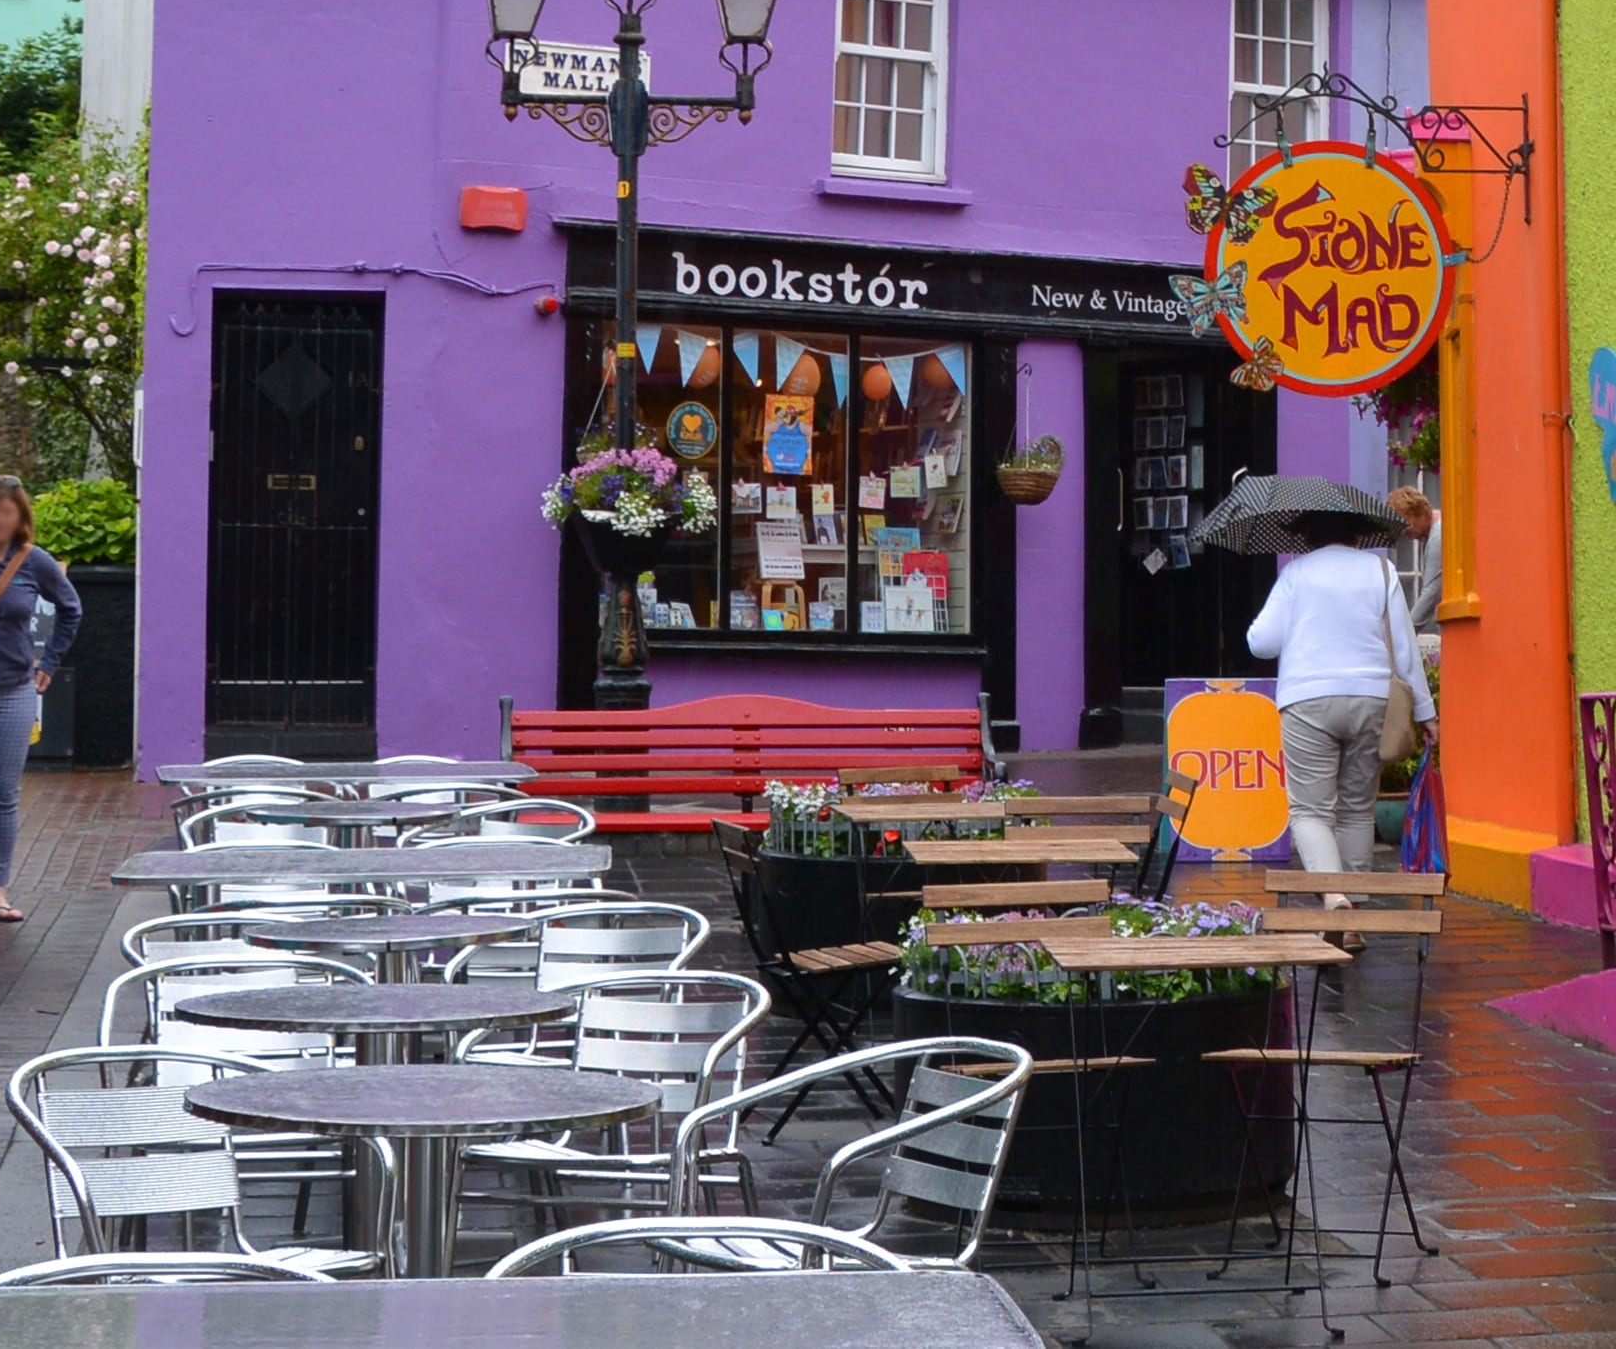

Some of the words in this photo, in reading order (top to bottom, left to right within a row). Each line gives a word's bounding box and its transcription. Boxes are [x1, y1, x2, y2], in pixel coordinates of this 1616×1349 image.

[543, 71, 609, 92] MALL
[1257, 179, 1432, 301] STONE
[672, 251, 928, 310] bookstór
[1031, 284, 1084, 309] New
[1090, 289, 1107, 310] &
[1112, 289, 1187, 322] Vintage
[1279, 280, 1421, 359] MAD
[1170, 749, 1287, 790] OPEN
